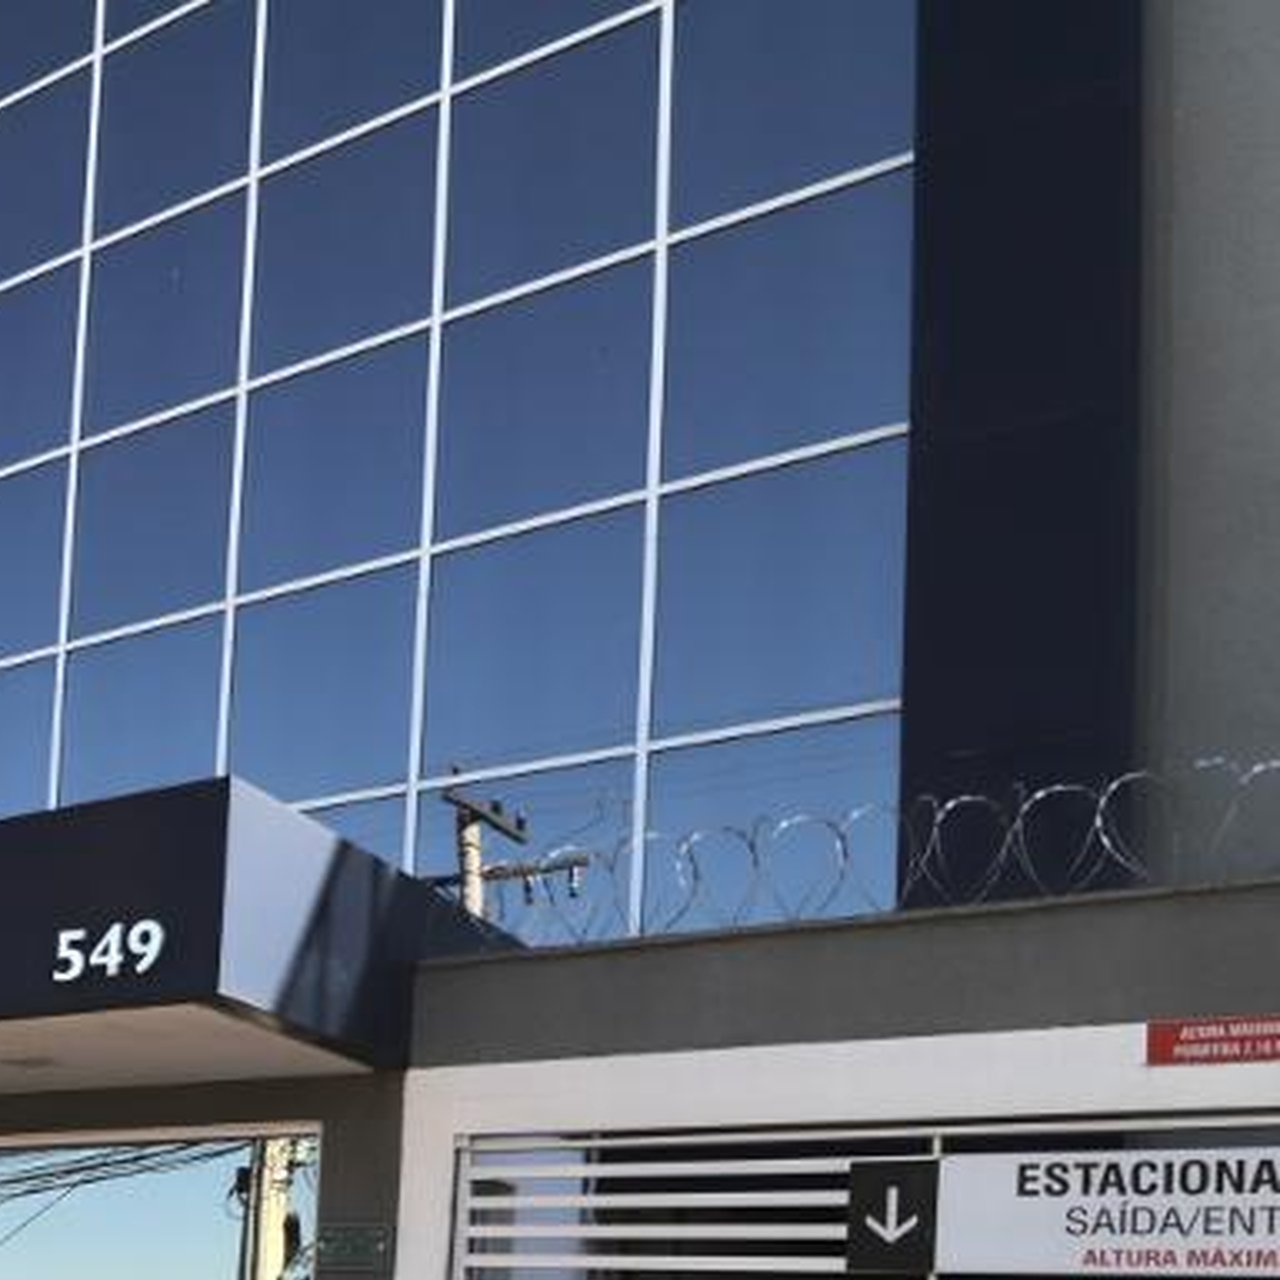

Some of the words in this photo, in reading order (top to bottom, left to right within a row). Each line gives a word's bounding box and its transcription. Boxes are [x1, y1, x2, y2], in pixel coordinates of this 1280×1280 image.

[52, 918, 165, 981] 549
[1017, 1159, 1280, 1196] ESTACIONA
[1065, 1202, 1280, 1237] SAÍDA/ENT
[1082, 1248, 1178, 1268] ALTURA
